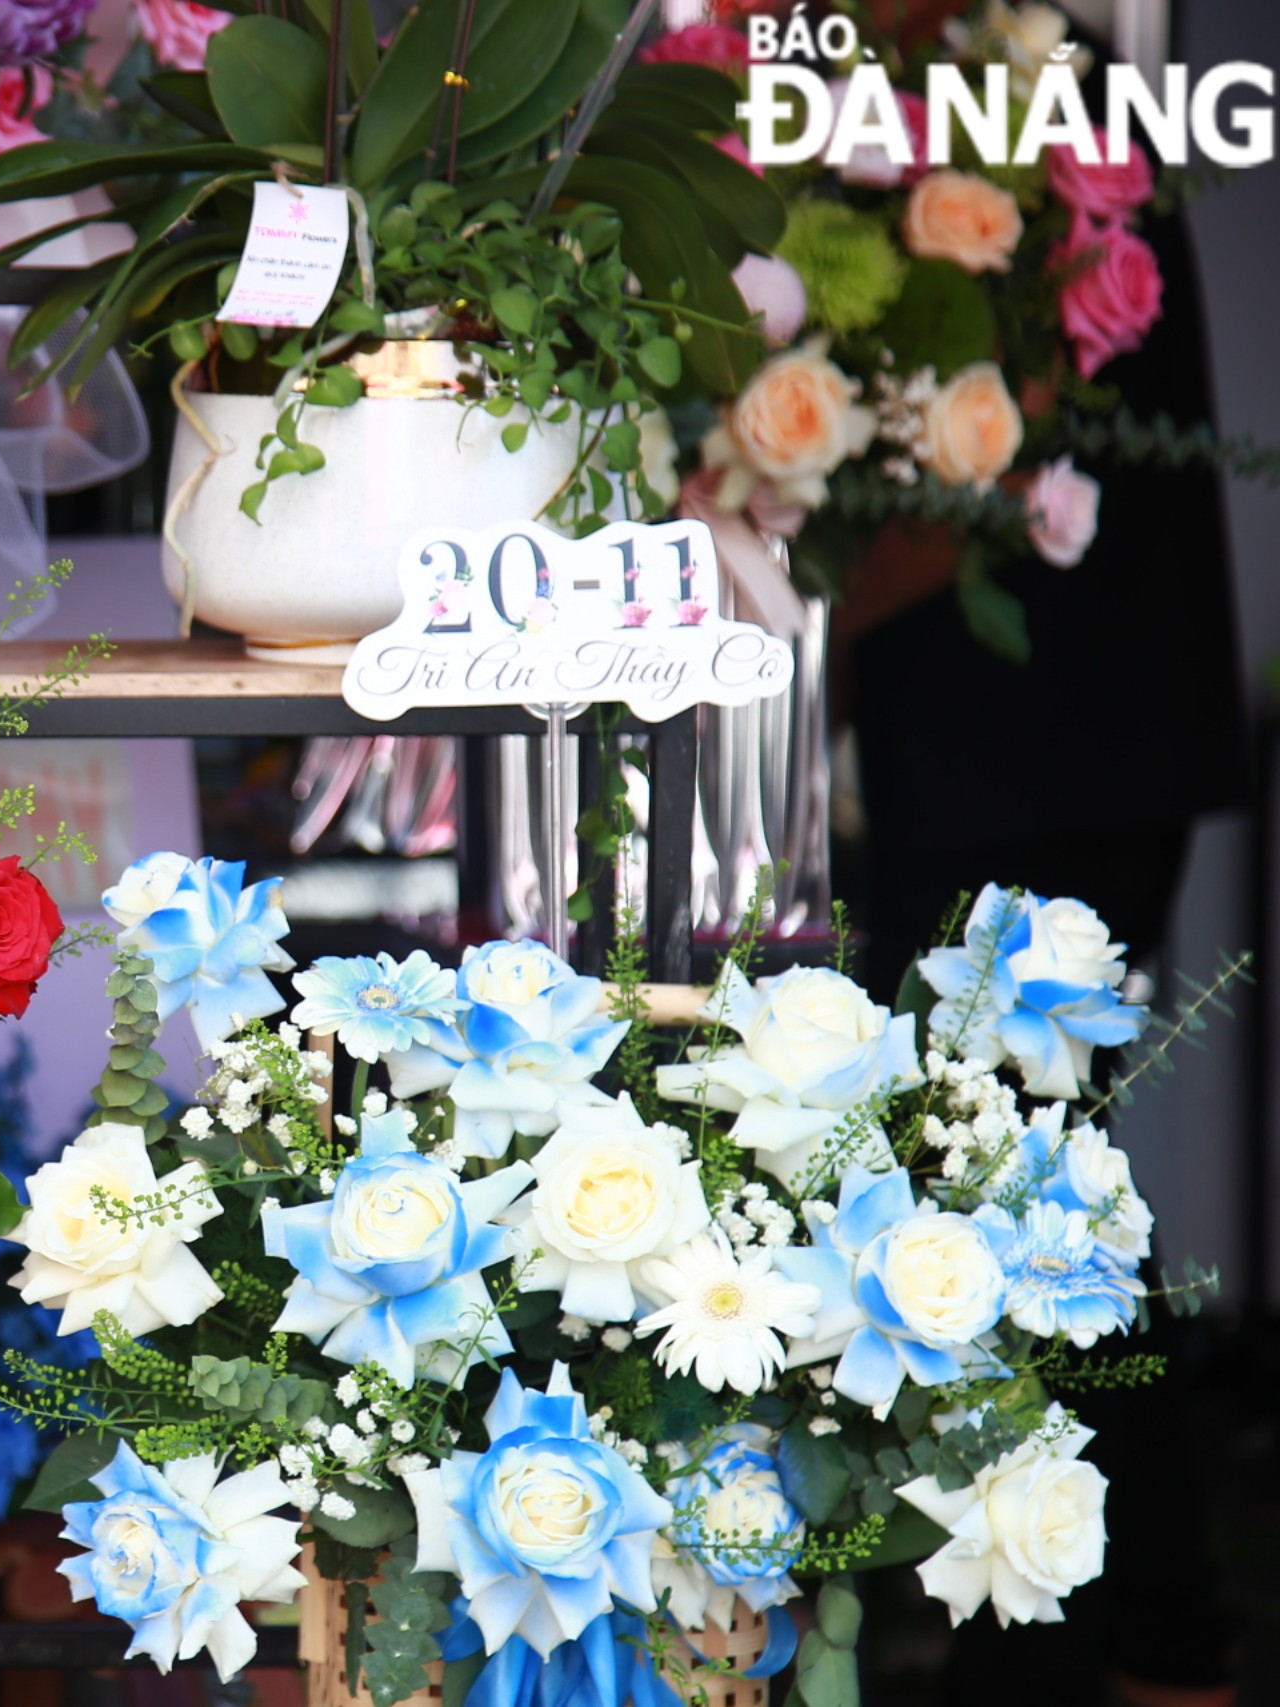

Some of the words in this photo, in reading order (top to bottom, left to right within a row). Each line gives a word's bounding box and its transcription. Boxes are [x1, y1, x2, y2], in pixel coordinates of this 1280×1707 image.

[419, 533, 708, 633] 20-11
[357, 645, 449, 696] Tri
[465, 633, 539, 691] Ân
[555, 641, 695, 701] Thầy
[712, 633, 784, 687] Cô
